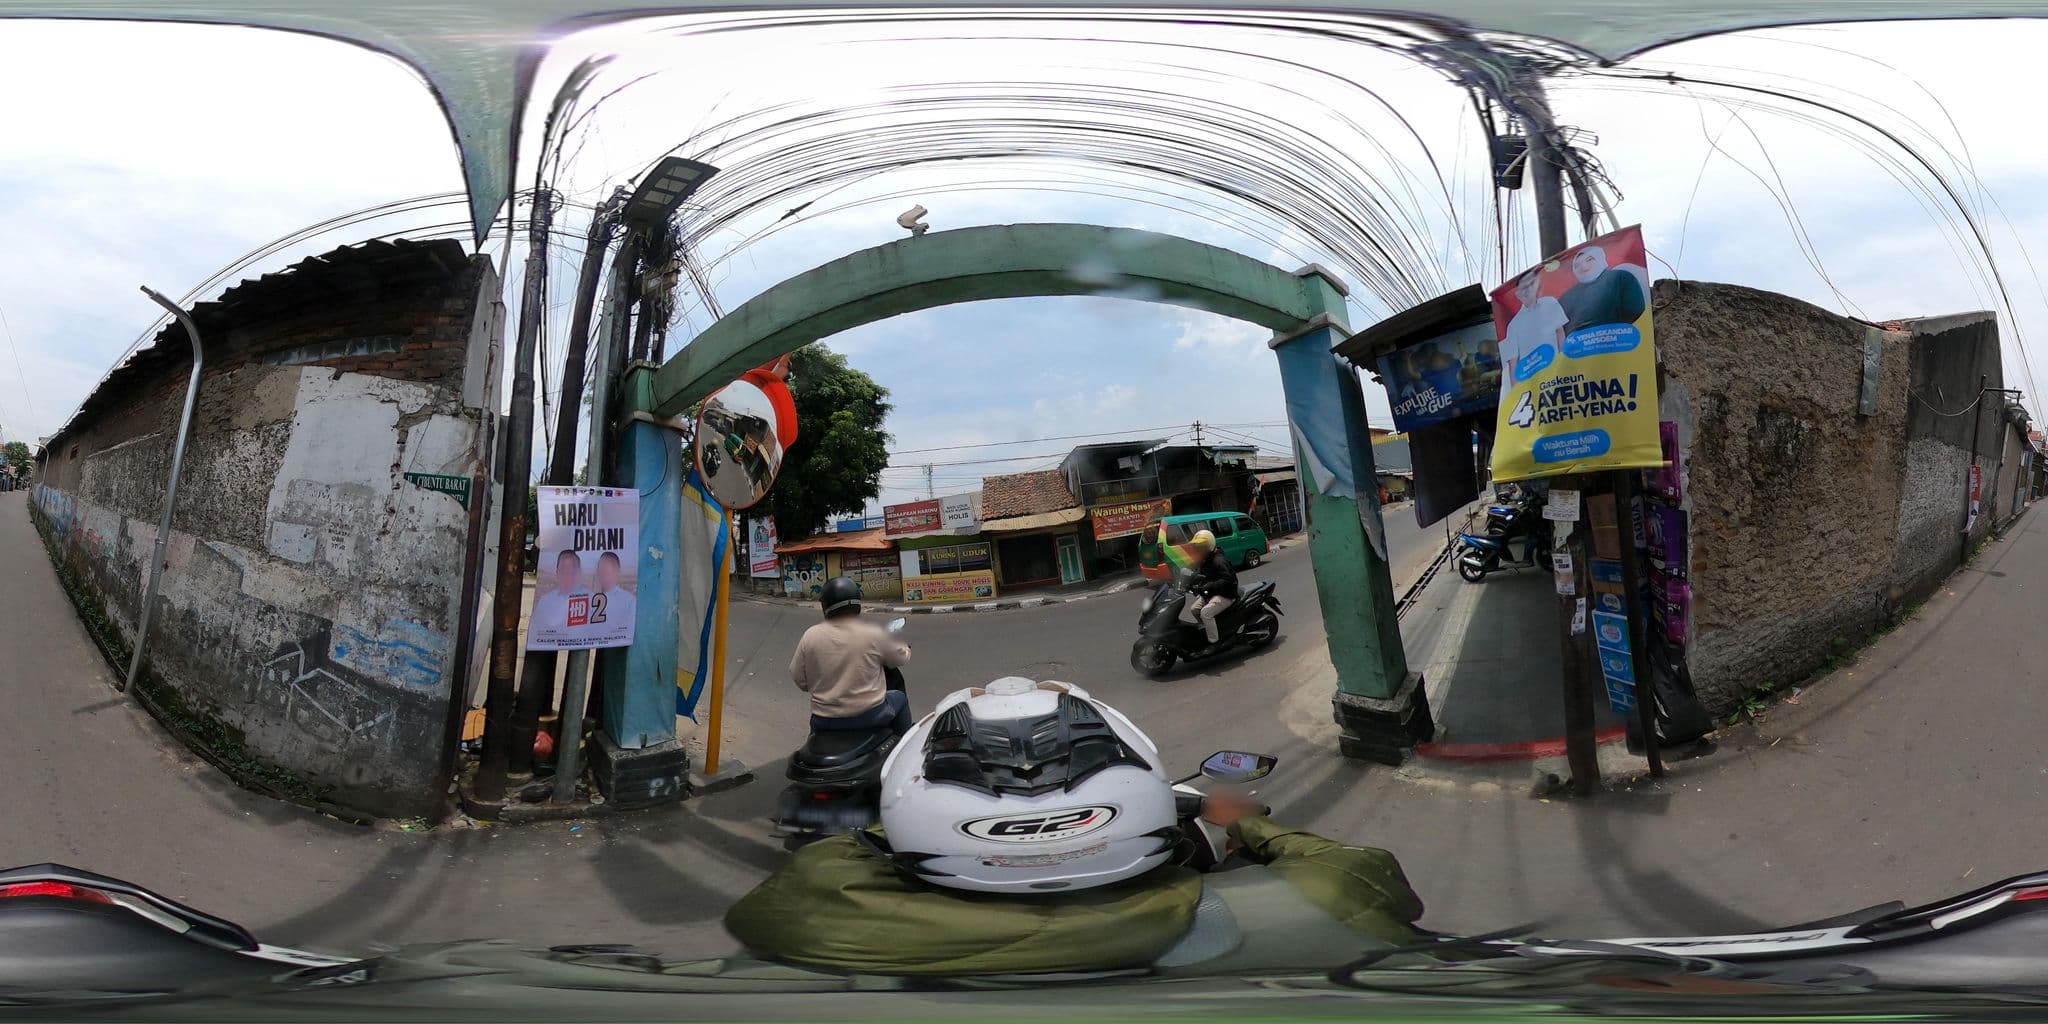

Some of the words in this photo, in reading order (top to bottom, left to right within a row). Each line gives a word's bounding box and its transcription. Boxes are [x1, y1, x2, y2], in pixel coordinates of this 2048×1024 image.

[1596, 327, 1633, 337] ISKANDAR
[1539, 374, 1584, 390] Gaskeun
[1394, 386, 1438, 416] EXPLORE
[1428, 392, 1453, 414] GUE
[1508, 390, 1534, 428] 4
[1538, 398, 1627, 426] ARFI-YENA
[1542, 438, 1579, 451] Waktuna
[1580, 434, 1600, 445] Milih
[1554, 449, 1565, 457] nu
[1566, 445, 1591, 455] Bersih
[445, 478, 467, 491] BARAT
[554, 503, 598, 526] HARU
[948, 512, 969, 520] HOLIS
[1093, 506, 1130, 517] Warung
[1130, 503, 1151, 511] Nasi
[574, 528, 624, 552] DHANI
[962, 549, 987, 557] UDUK
[590, 592, 608, 624] 2
[987, 809, 1094, 836] G2
